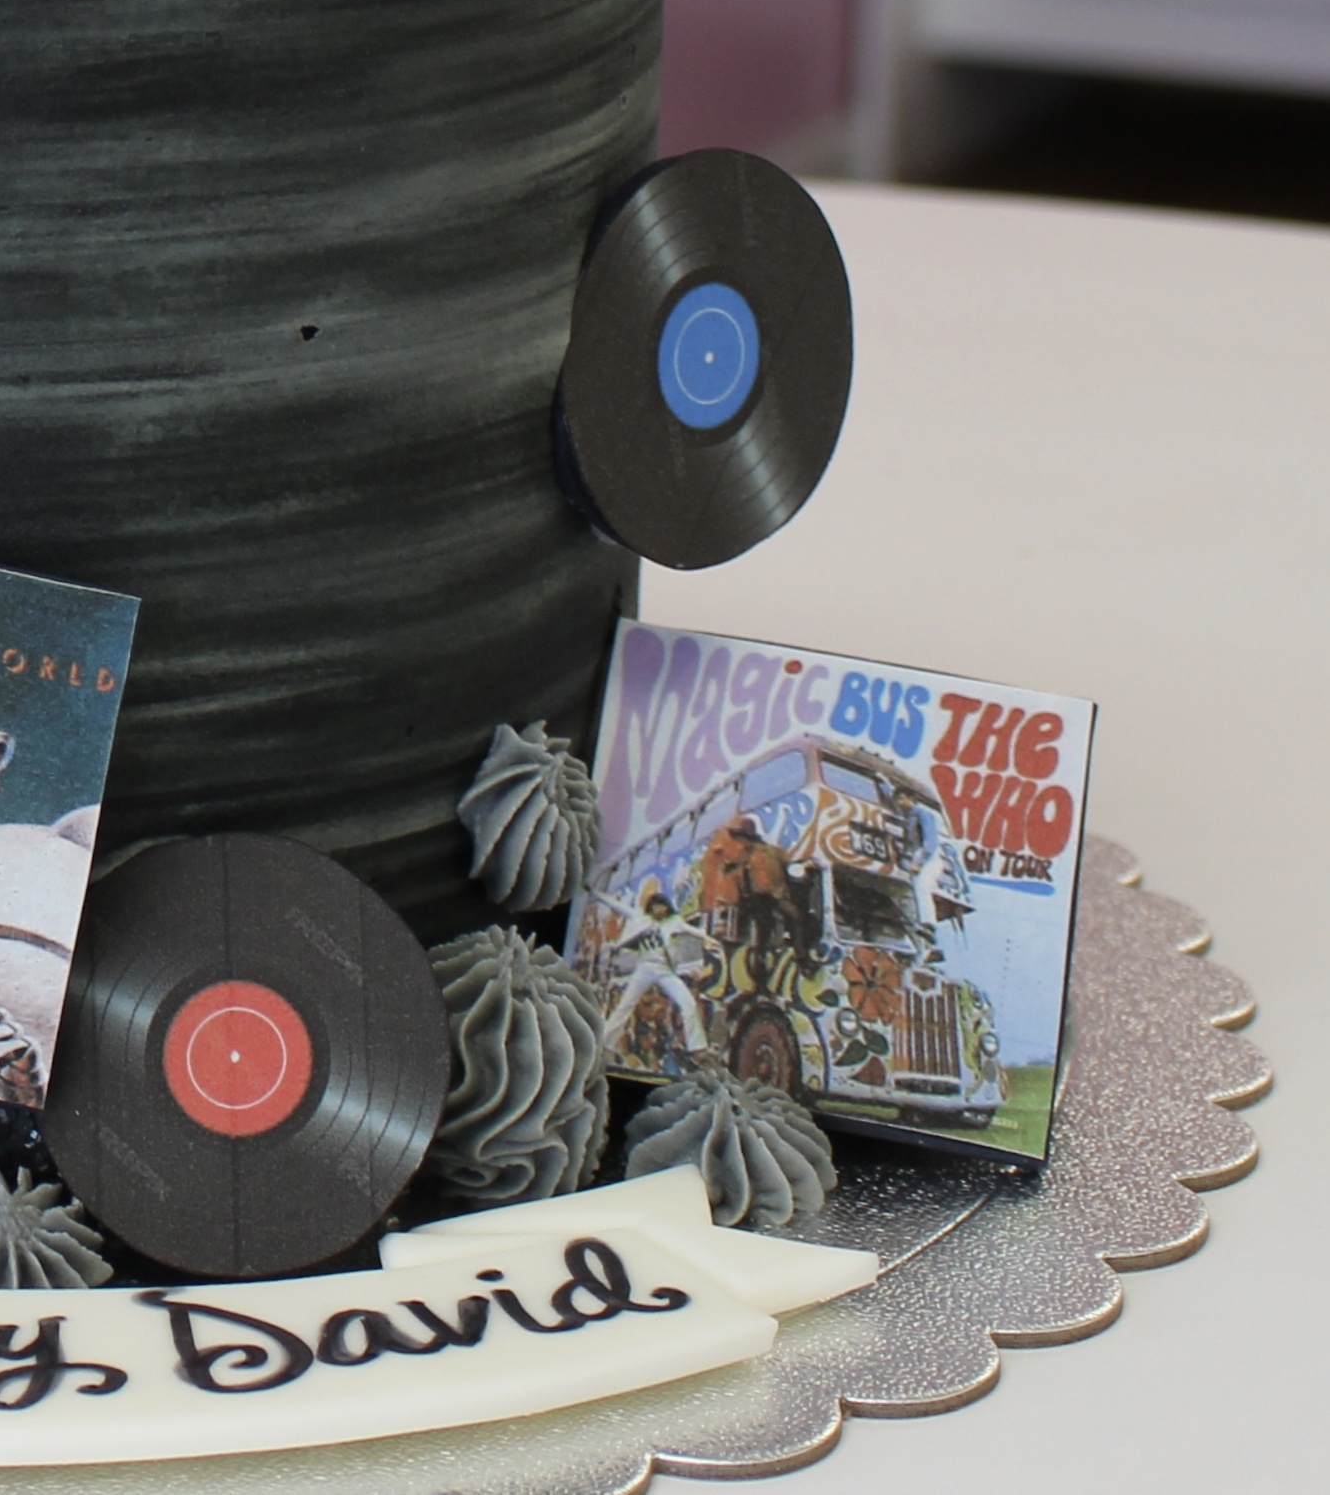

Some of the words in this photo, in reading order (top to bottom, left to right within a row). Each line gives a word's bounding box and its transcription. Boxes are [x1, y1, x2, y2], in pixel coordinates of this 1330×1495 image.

[596, 627, 829, 861] Magic
[829, 671, 931, 759] BUS
[929, 763, 1074, 858] WHO
[963, 845, 993, 876] ON
[1000, 849, 1054, 883] TOUR
[133, 1236, 691, 1394] David
